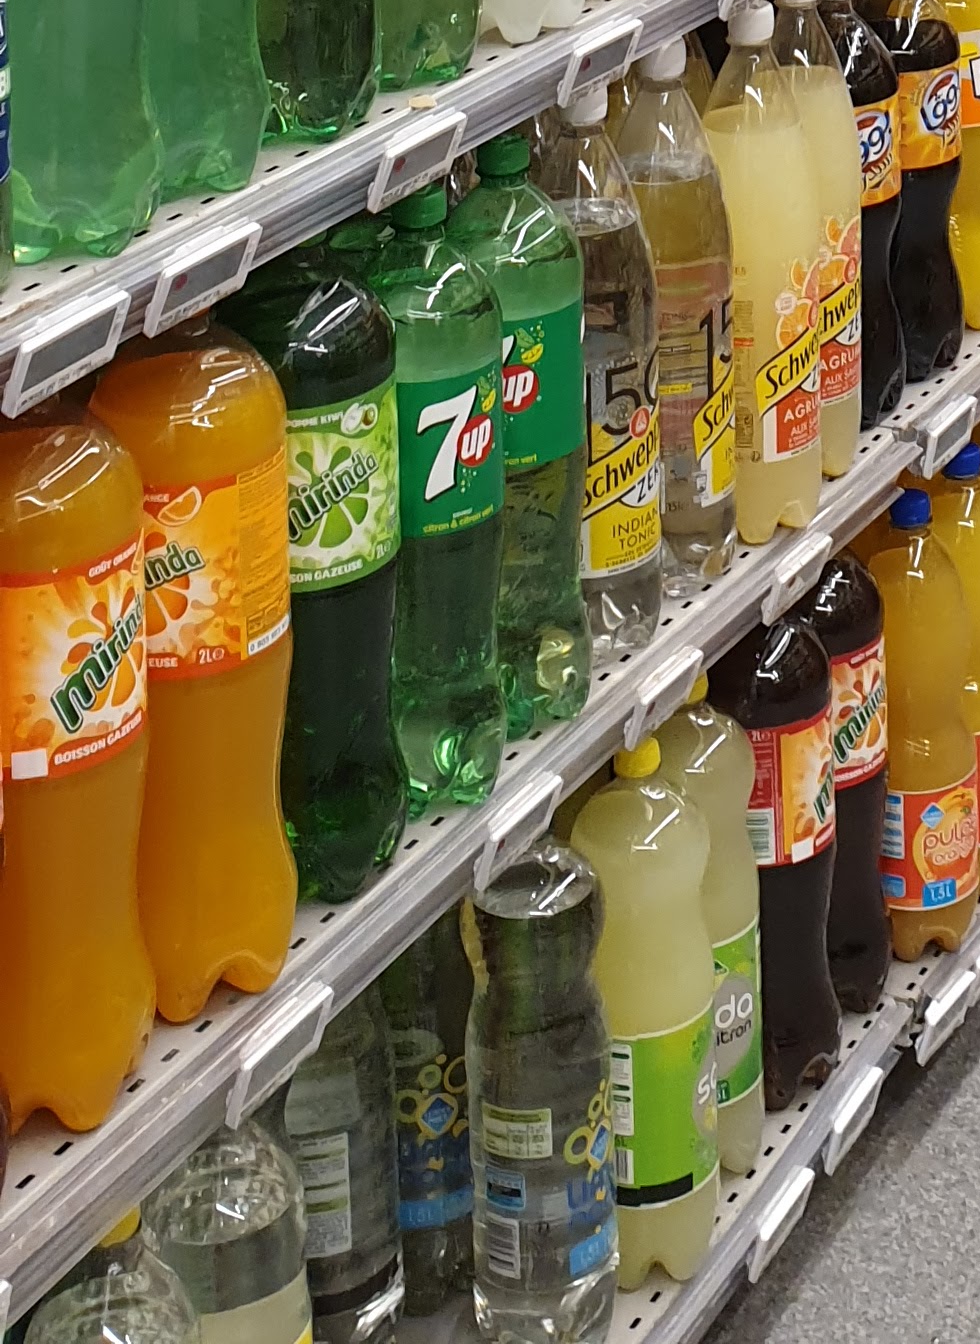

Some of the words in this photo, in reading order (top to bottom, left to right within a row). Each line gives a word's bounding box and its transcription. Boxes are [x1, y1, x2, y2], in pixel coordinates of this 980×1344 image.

[503, 369, 535, 407] up
[416, 384, 494, 504] 7up
[314, 558, 364, 581] GAZEUSE
[148, 657, 179, 669] EUSE
[53, 738, 107, 767] BOISSON
[716, 1019, 753, 1049] itron
